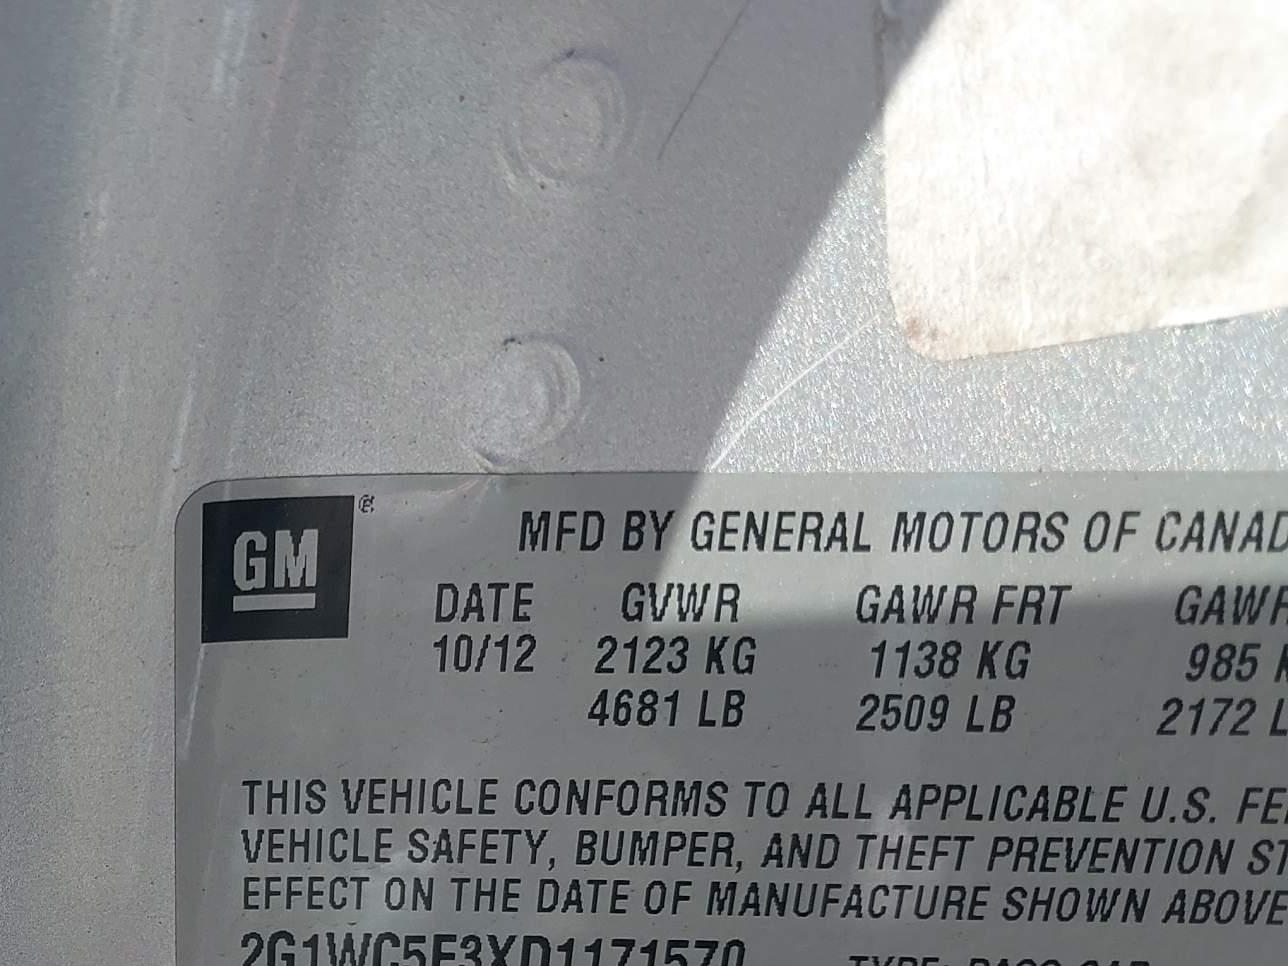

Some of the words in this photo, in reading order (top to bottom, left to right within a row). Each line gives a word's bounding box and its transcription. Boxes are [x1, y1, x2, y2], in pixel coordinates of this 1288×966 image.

[519, 511, 604, 551] MFD
[623, 510, 676, 551] BY
[691, 511, 870, 552] GENERAL
[892, 511, 1069, 552] MOTORS
[1084, 511, 1141, 552] OF
[233, 529, 319, 591] GM
[435, 583, 533, 622] DATE
[622, 582, 740, 622] GVWR
[856, 585, 977, 624] GAWR
[992, 585, 1072, 625] FRT
[434, 634, 536, 672] 10/12
[595, 636, 689, 673] 2123
[705, 636, 756, 674] KG
[872, 640, 961, 678] 1138
[977, 641, 1031, 679] KG
[1186, 643, 1260, 681] 985
[588, 689, 679, 726] 4681
[699, 690, 745, 727] LB
[856, 694, 949, 731] 2509
[966, 695, 1015, 732] LB
[1157, 697, 1256, 735] 2172
[242, 779, 326, 815] THIS
[342, 779, 498, 814] VEHICLE
[515, 779, 728, 816] CONFORMS
[745, 782, 789, 817] TO
[805, 783, 872, 819] ALL
[889, 784, 1127, 822] APPLICABLE
[1141, 787, 1215, 823] U.S.
[1237, 788, 1288, 824] FE
[241, 828, 392, 863] VEHICLE
[408, 829, 556, 871] SAFETY,
[576, 830, 744, 871] BUMPER,
[761, 833, 840, 868] AND
[856, 835, 974, 871] THEFT
[988, 837, 1235, 874] PREVENTION
[244, 877, 369, 909] EFFECT
[385, 877, 433, 911] ON
[451, 878, 521, 912] THE
[537, 879, 630, 913] DATE
[644, 881, 692, 914] OF
[707, 882, 990, 920] MANUFACTURE
[1002, 887, 1150, 922] SHOWN
[1162, 889, 1288, 925] ABOVE
